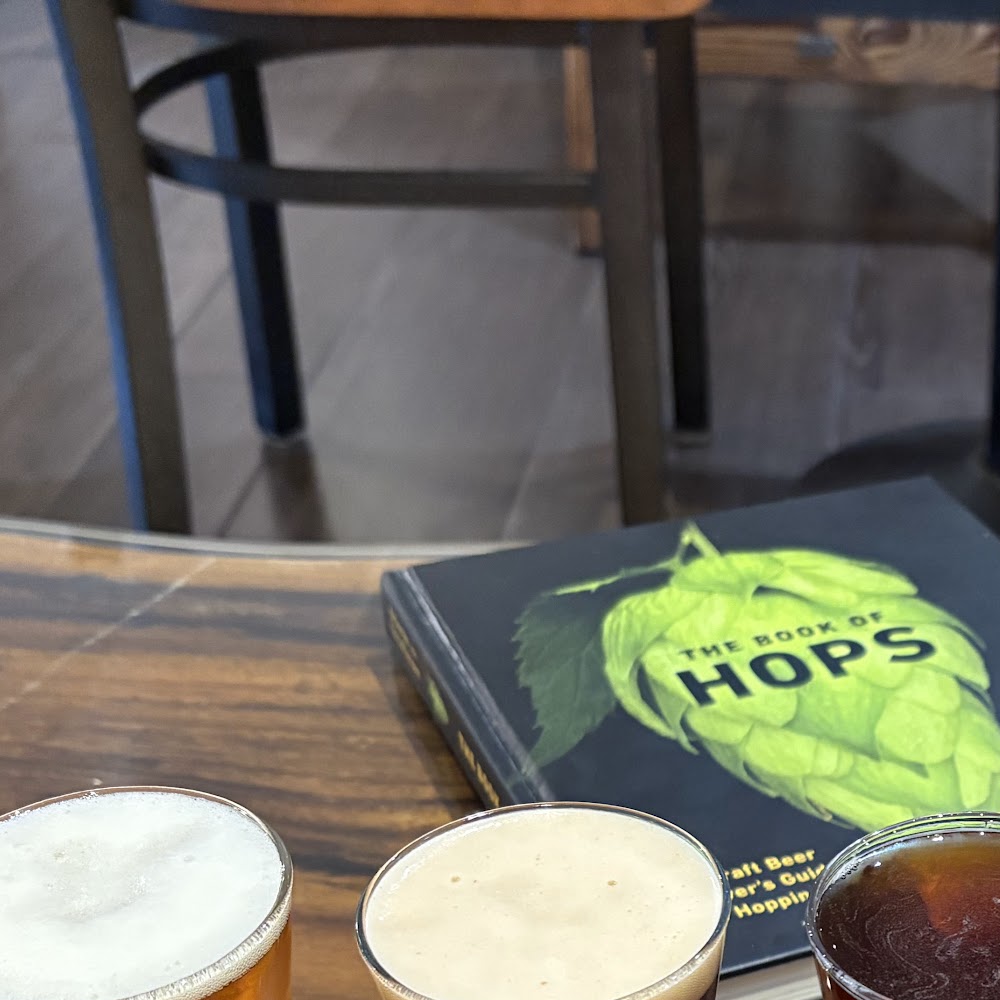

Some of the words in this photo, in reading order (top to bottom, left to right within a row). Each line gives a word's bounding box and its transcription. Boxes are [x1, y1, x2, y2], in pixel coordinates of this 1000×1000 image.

[678, 640, 742, 661] THE
[752, 621, 837, 647] BOOK
[849, 611, 884, 628] OF
[676, 626, 936, 707] HOPS
[724, 861, 763, 880] raft
[763, 849, 815, 871] Beer
[733, 890, 810, 918] Hoppin
